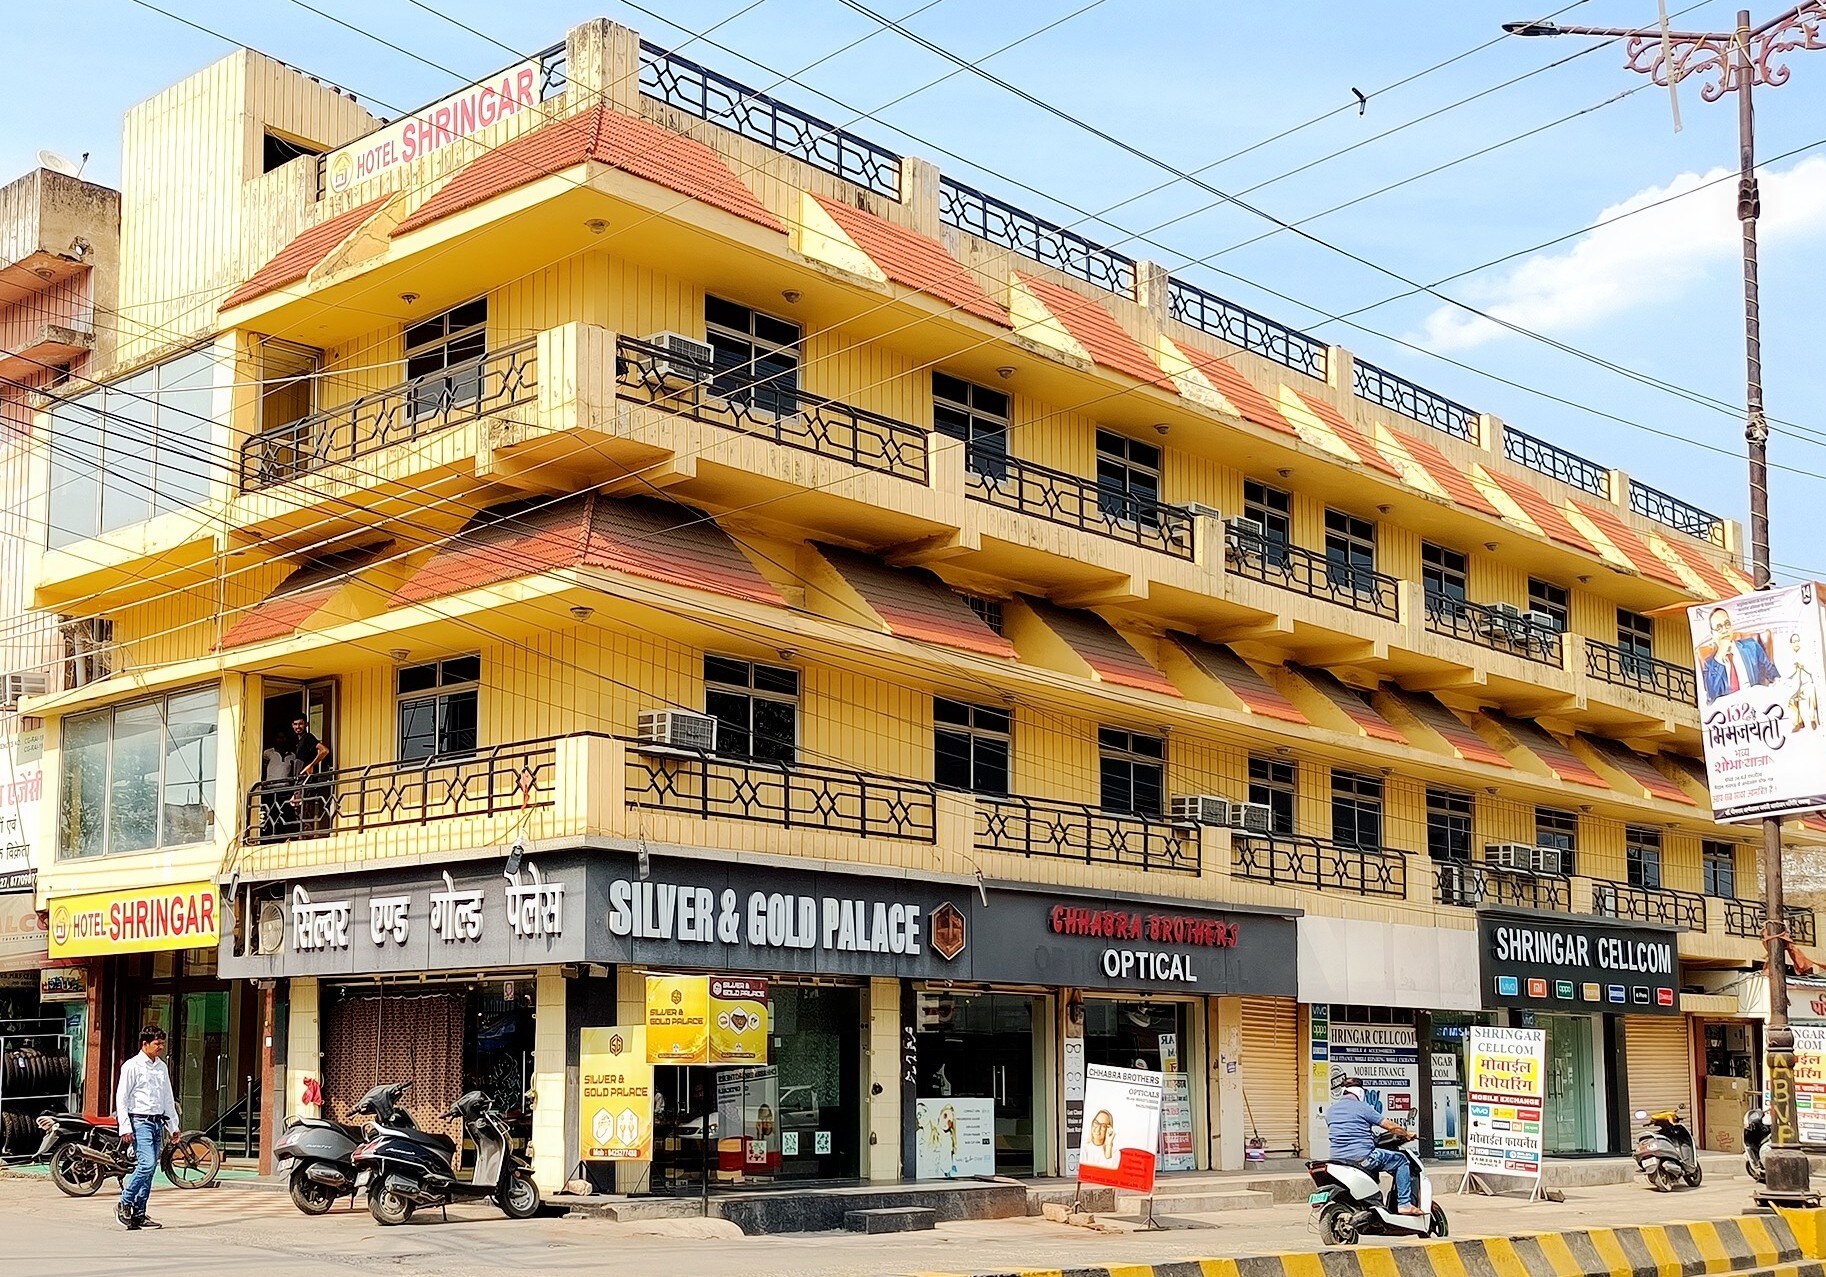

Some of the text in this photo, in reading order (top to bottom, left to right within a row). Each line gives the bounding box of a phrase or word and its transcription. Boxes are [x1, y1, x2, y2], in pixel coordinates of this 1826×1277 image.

[357, 68, 534, 179] HOTEL SHRINGAR
[292, 884, 351, 949] सिल्वर
[369, 895, 411, 944] एण्ड
[430, 870, 484, 941] गोल्ड
[608, 879, 921, 955] SILVER & GOLD PALACE
[73, 893, 216, 942] HOTEL SHRINGAR
[1051, 904, 1241, 948] CHHABRA BROTHERS
[1496, 926, 1672, 974] SHRINGAR CELLCOM
[1103, 949, 1198, 983] OPTICAL
[650, 1008, 677, 1016] SILVER
[650, 1017, 704, 1026] GOLD PALACE
[1372, 1030, 1415, 1046] CELLCOM
[1474, 1027, 1542, 1042] SHRINGAR
[1477, 1042, 1534, 1056] CELLCOM
[584, 1074, 625, 1084] SILVER &
[1089, 1068, 1160, 1085] CHHABRA BROTHERS
[1353, 1066, 1405, 1077] MOBILE FINANCE
[584, 1087, 648, 1097] GOLD PALACE
[1128, 1088, 1160, 1099] OPTICALS
[1471, 1093, 1540, 1106] MOBILE EXCHANGE
